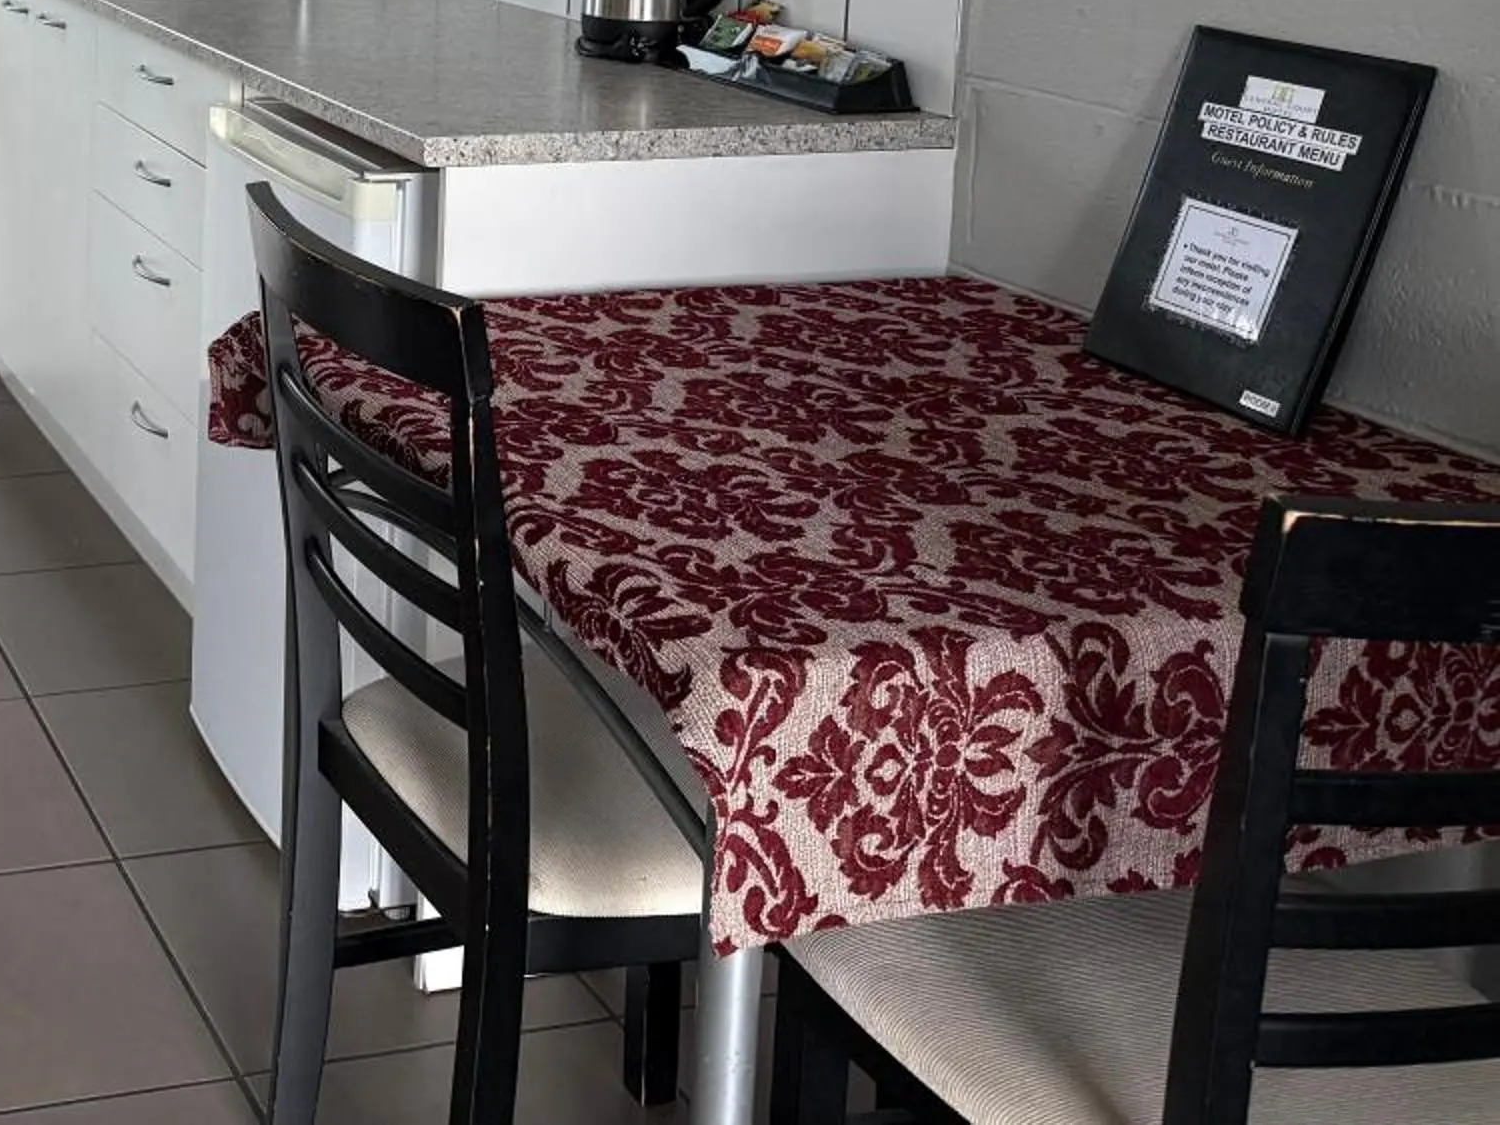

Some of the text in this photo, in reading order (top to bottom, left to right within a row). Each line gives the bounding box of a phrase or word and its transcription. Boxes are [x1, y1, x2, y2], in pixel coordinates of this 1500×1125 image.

[1203, 104, 1359, 150] MOTEL POLICY & RULES
[1207, 124, 1342, 166] RESTAURANT MENU
[1210, 151, 1315, 188] Guest Information
